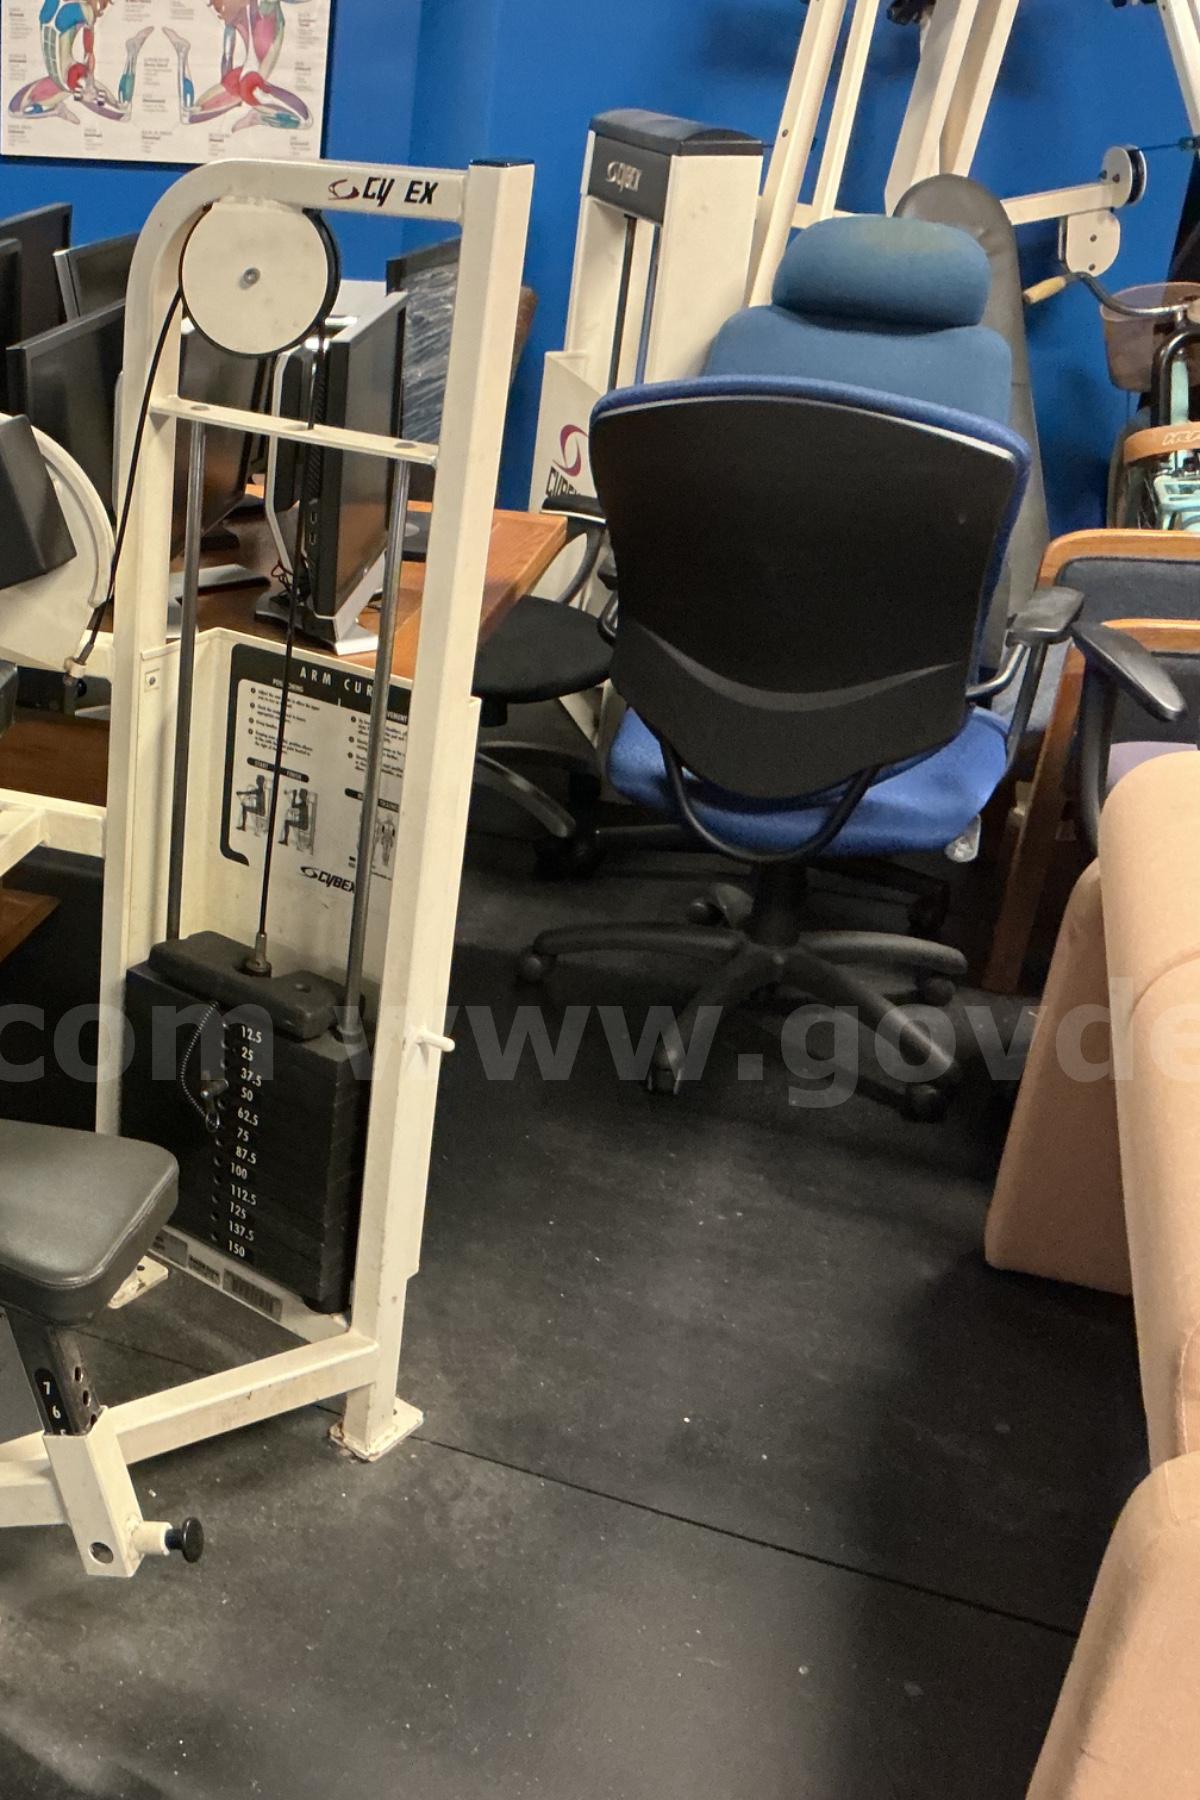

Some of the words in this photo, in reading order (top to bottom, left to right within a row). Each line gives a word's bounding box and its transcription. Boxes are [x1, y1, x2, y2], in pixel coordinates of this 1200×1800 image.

[300, 666, 332, 686] ARM
[344, 679, 374, 697] CUR
[241, 1025, 262, 1044] 12.5
[241, 1046, 254, 1062] 25
[240, 1067, 262, 1088] 37.5
[241, 1086, 254, 1102] 50
[237, 1107, 259, 1126] 62.5
[237, 1126, 250, 1142] 75
[235, 1145, 257, 1165] 87.5
[231, 1162, 248, 1180] 100
[231, 1184, 257, 1206] 112.5
[230, 1201, 247, 1219] 125
[229, 1220, 255, 1241] 137.5
[229, 1240, 246, 1258] 150
[43, 1381, 51, 1395] 7
[52, 1405, 61, 1419] 6
